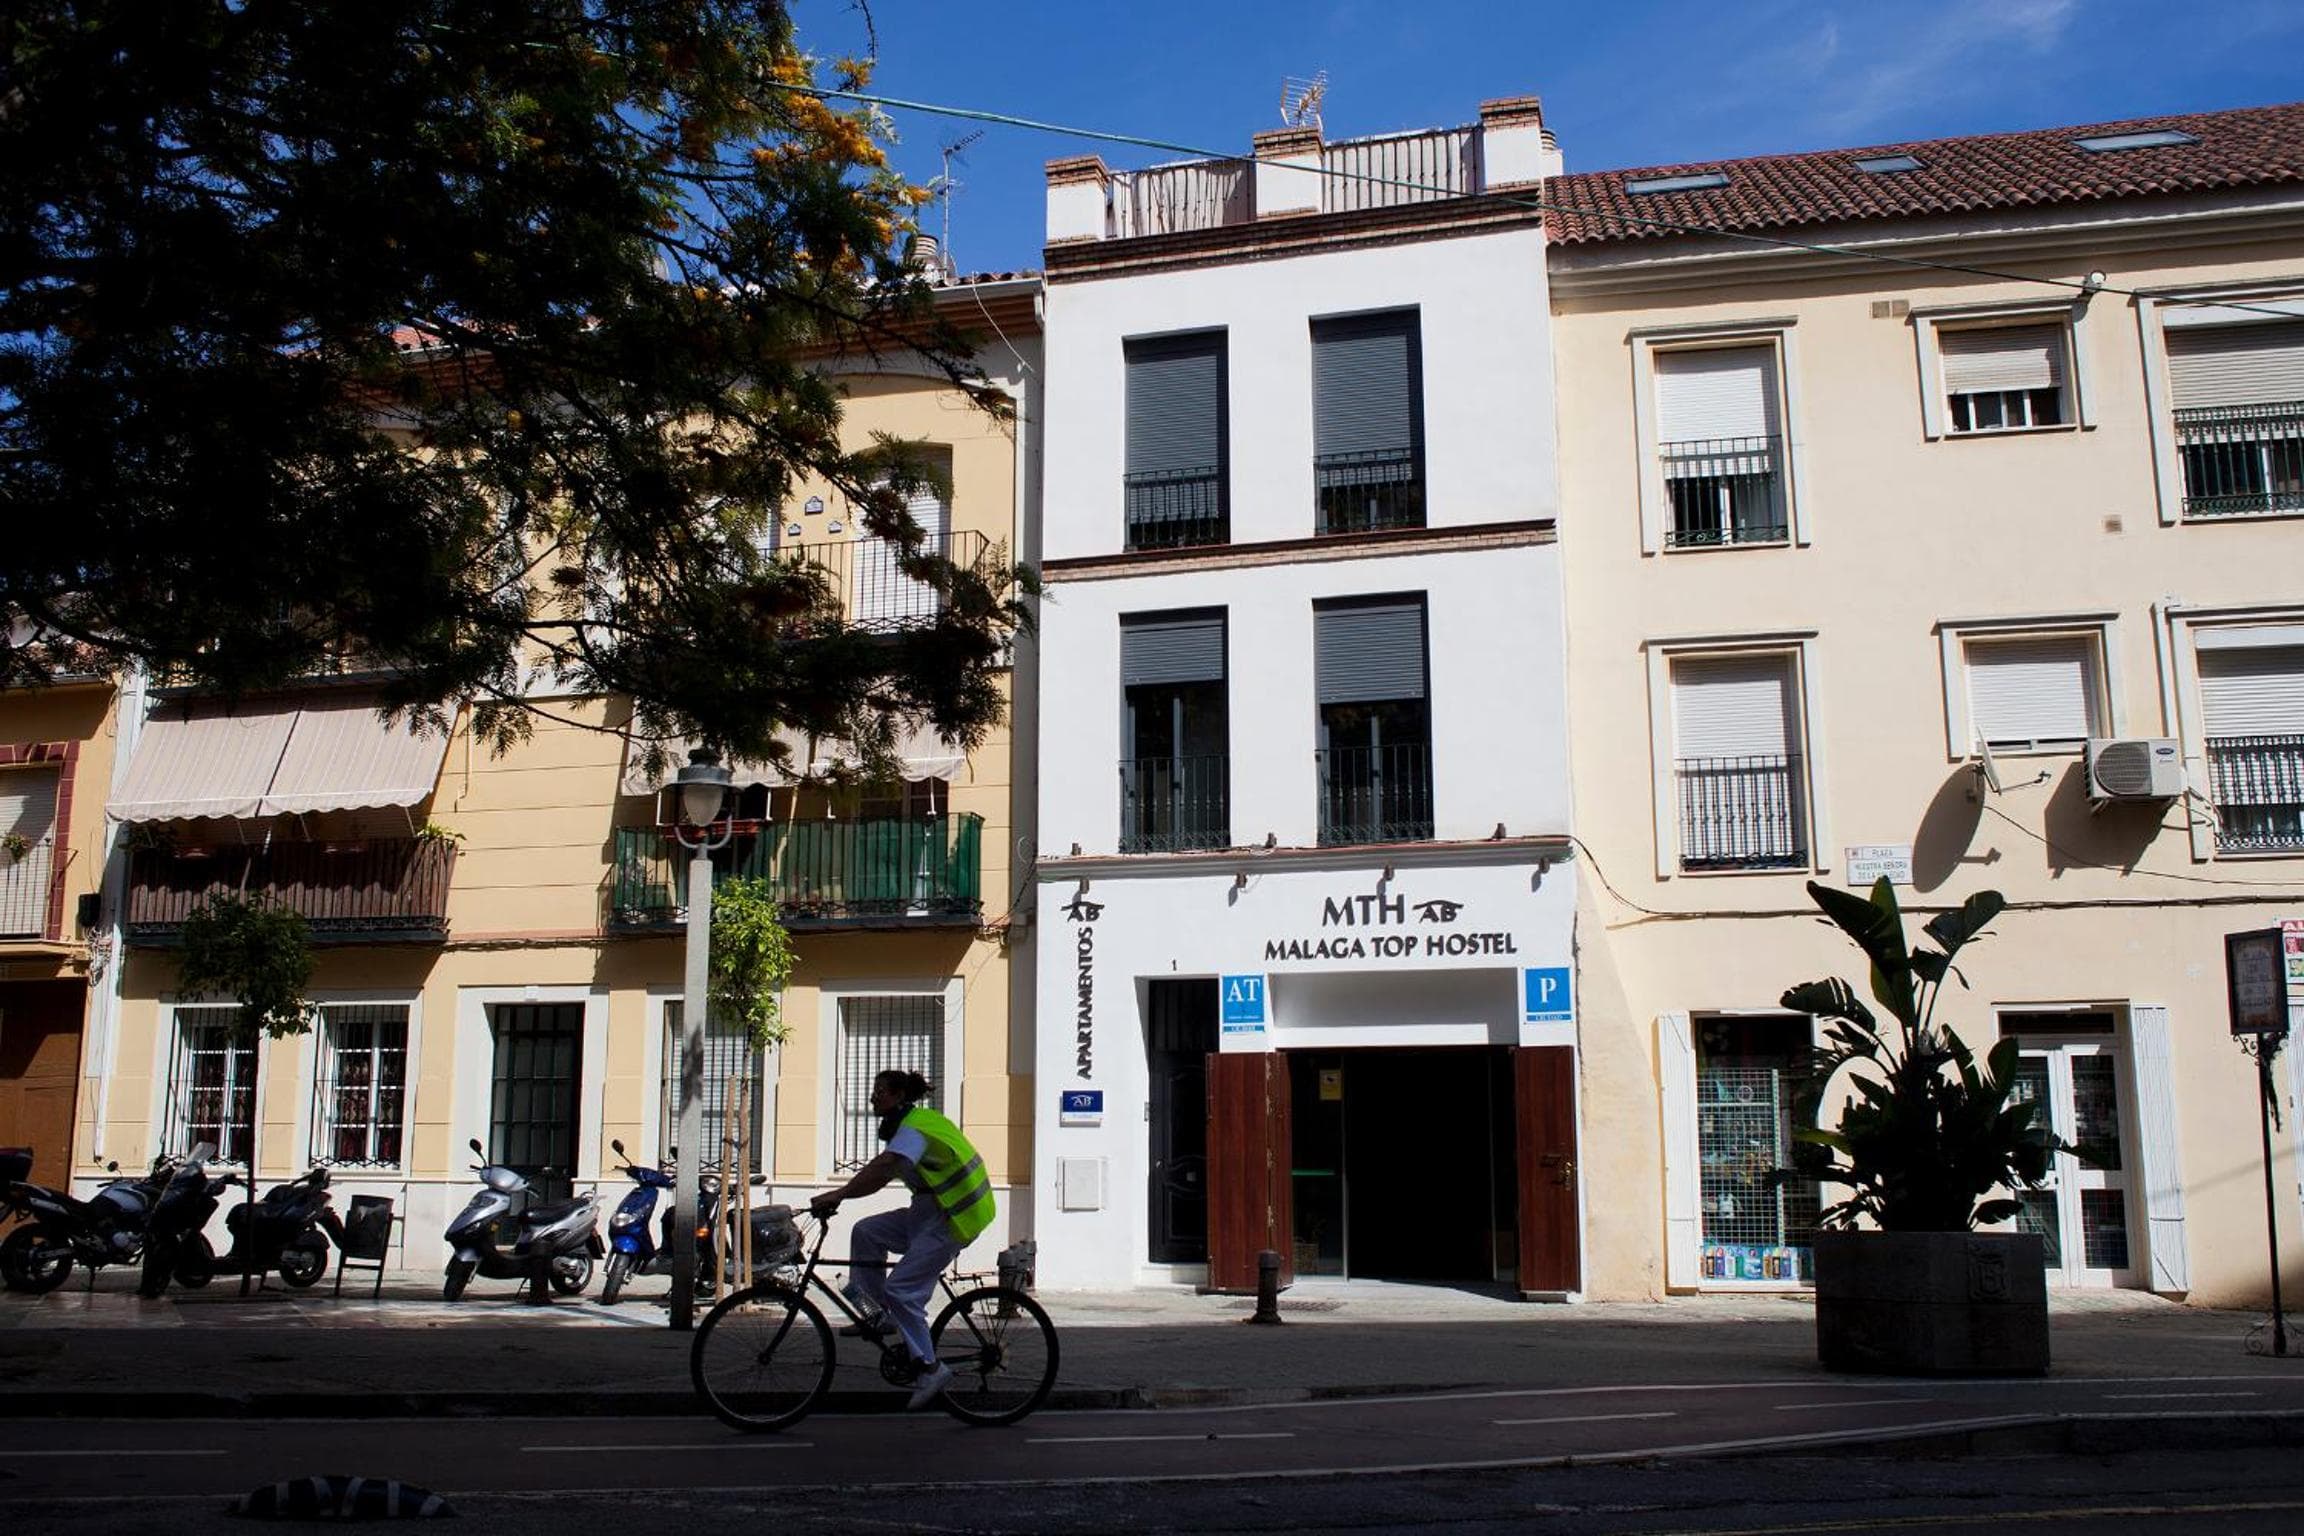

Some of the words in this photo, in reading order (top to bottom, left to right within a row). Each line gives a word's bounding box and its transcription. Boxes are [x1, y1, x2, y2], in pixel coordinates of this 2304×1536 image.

[1322, 894, 1405, 926] MTH
[1265, 937, 1366, 961] MALAGA
[1371, 935, 1418, 957] TOP
[1426, 932, 1517, 956] HOSTEL
[1172, 959, 1177, 971] 1
[1227, 979, 1260, 1002] AT
[1540, 977, 1557, 1003] P
[1077, 927, 1093, 1080] APARTAMENTOS
[1072, 1096, 1093, 1107] AB
